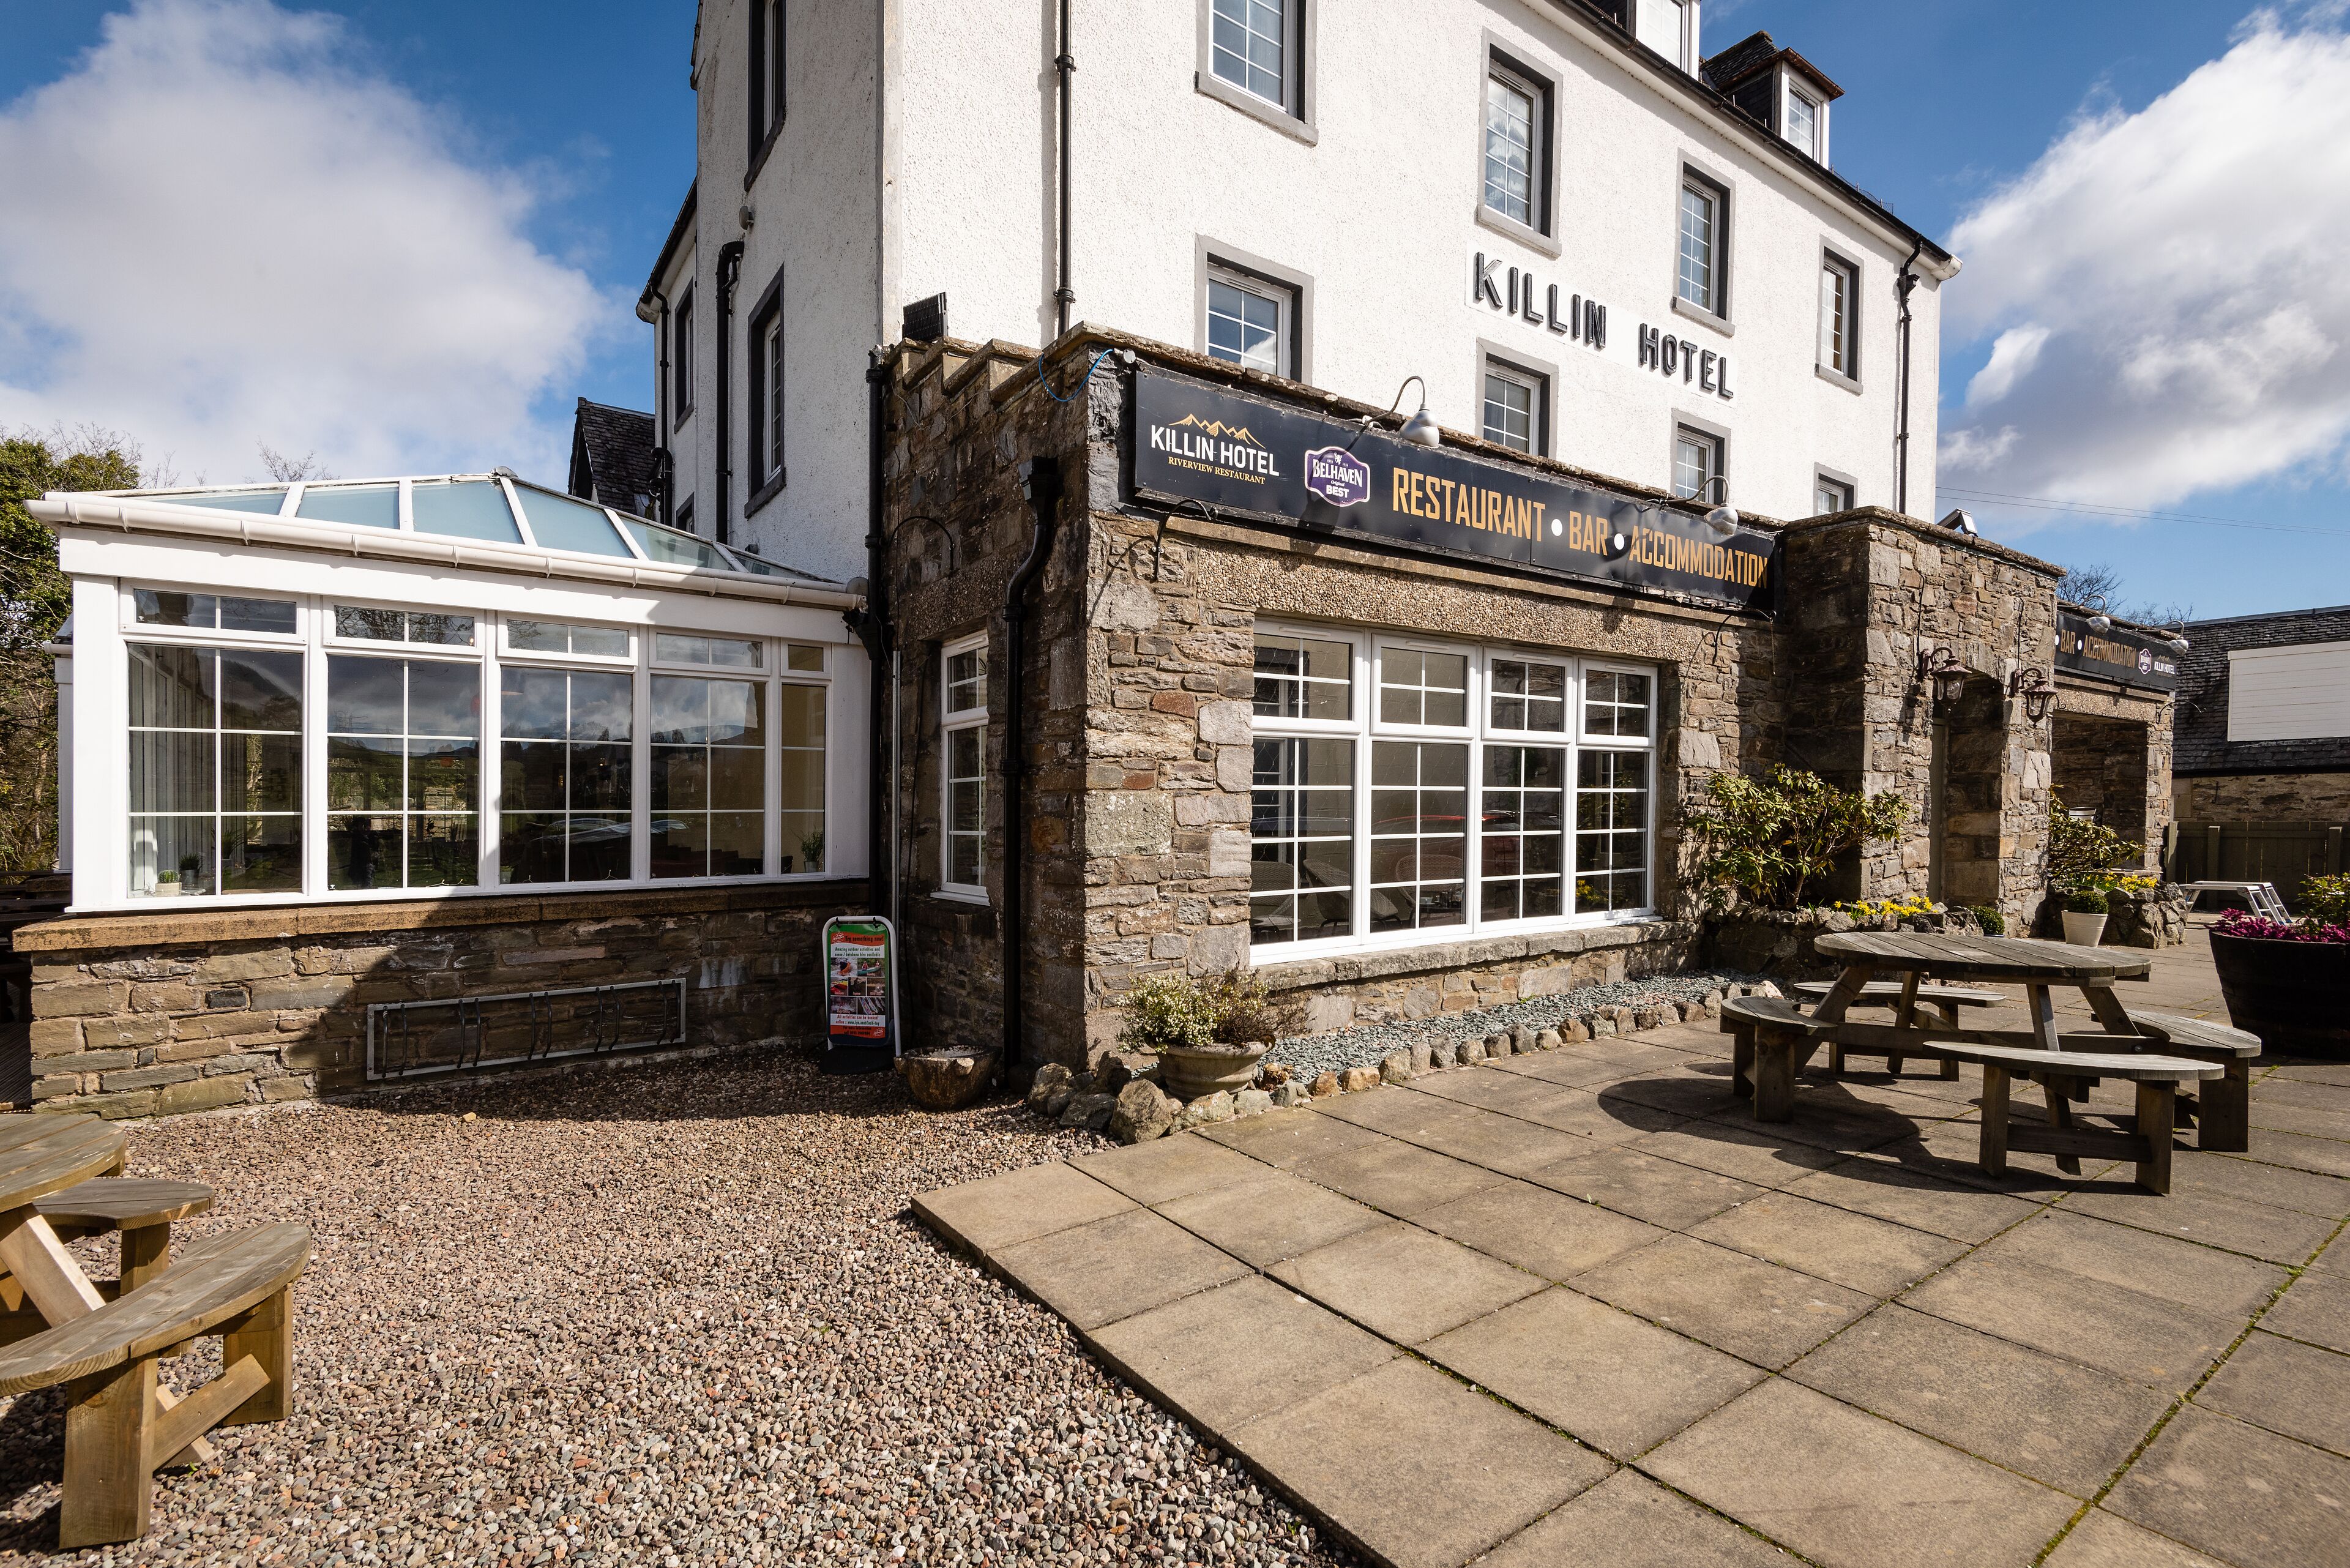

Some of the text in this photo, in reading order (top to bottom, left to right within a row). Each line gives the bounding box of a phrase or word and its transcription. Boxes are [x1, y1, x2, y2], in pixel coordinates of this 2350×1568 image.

[1474, 252, 1734, 399] KILLIN HOTEL
[1151, 424, 1279, 477] KILLIN HOTEL
[1168, 456, 1266, 485] RIVERVIEW RESTAURANT
[1313, 458, 1362, 487] BELHAVEN
[1326, 485, 1349, 498] BEST
[1392, 466, 1768, 589] RESTAURANT BAR ACCOMMODATION
[2061, 629, 2136, 668] BAR ACCOMMODATION
[2165, 663, 2175, 674] HOTEL
